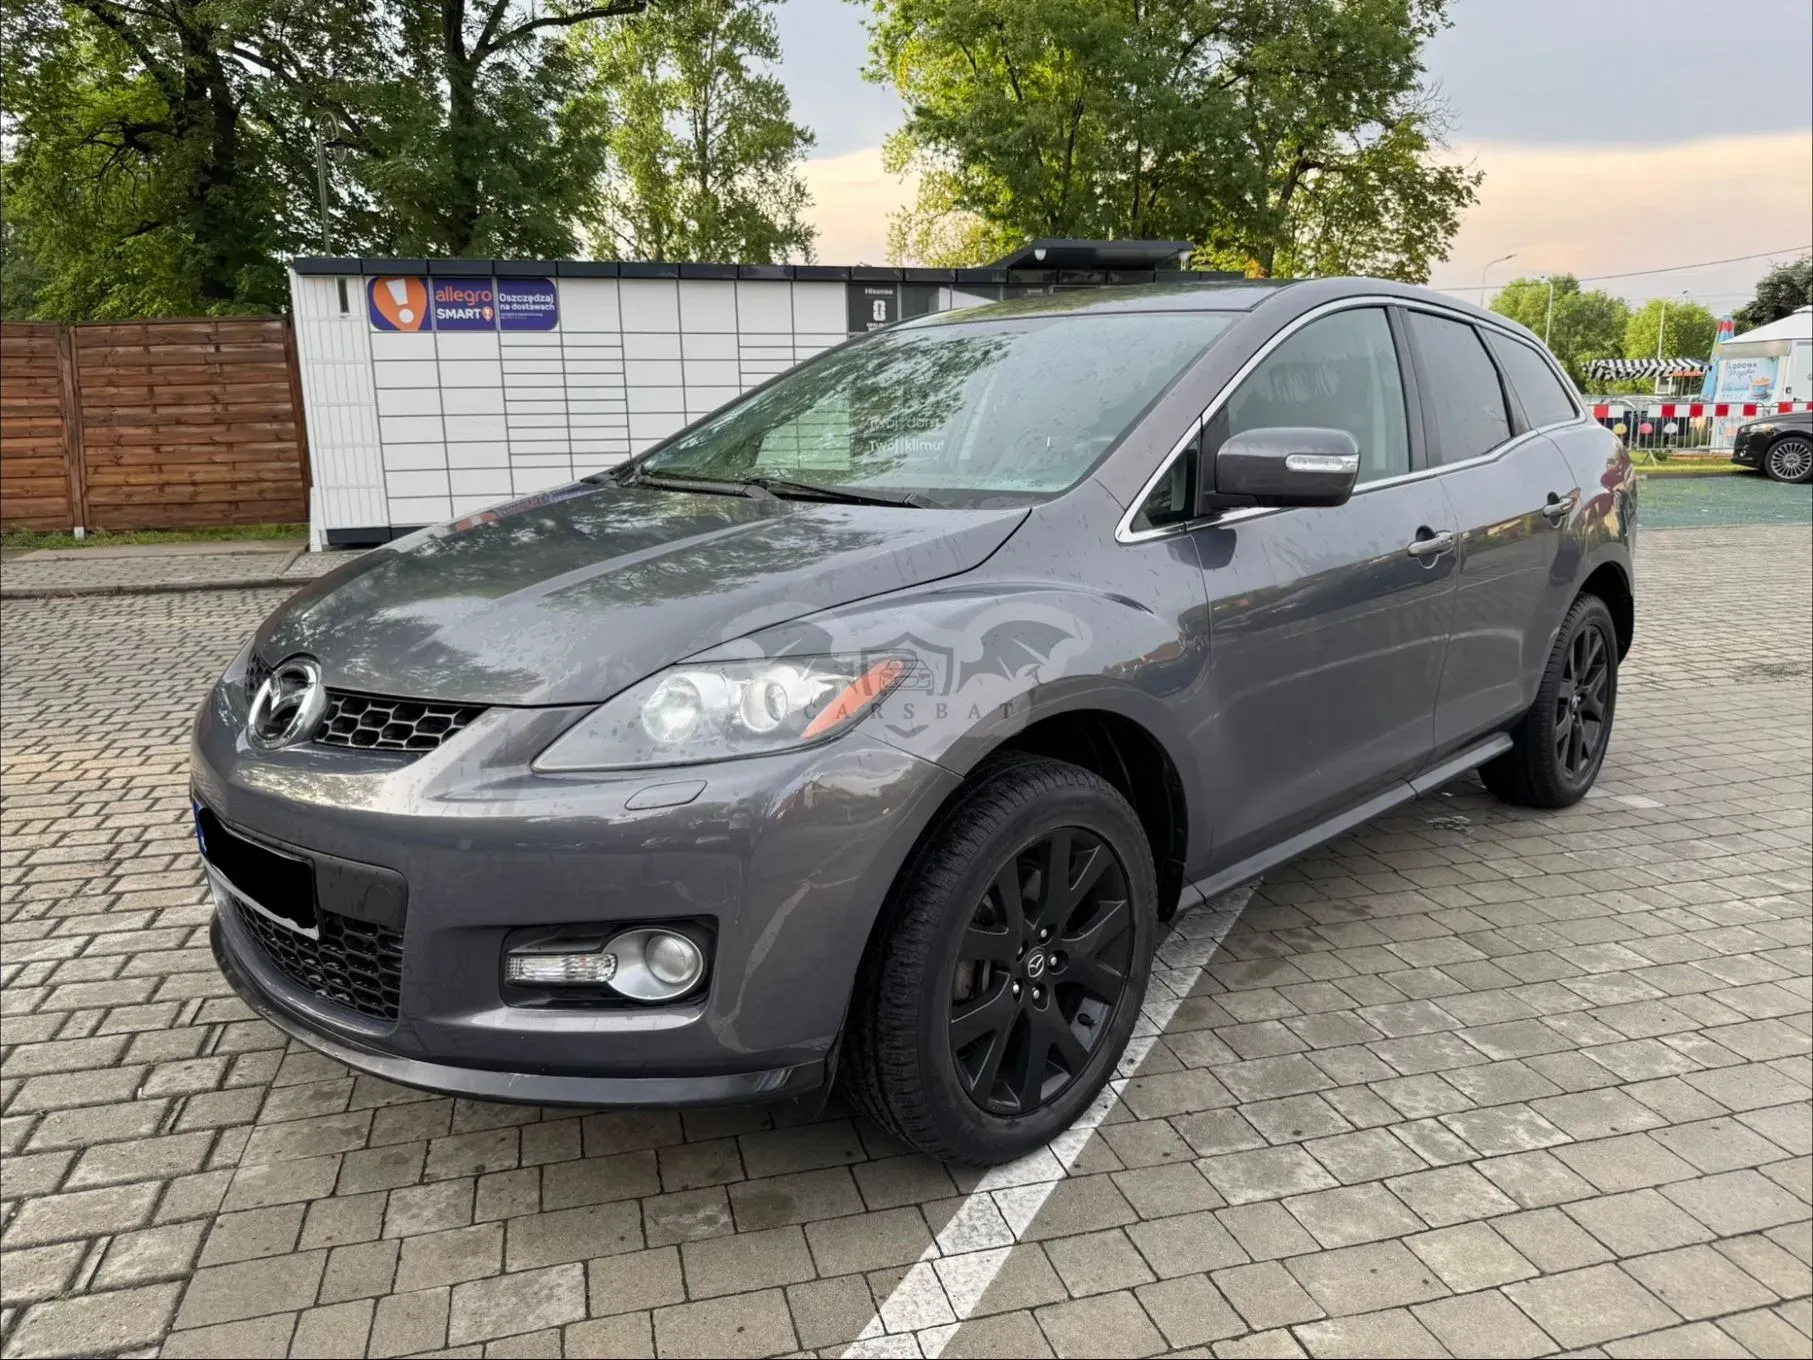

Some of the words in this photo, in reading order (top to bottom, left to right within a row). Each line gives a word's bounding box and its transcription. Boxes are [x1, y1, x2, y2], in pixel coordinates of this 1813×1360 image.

[436, 286, 492, 306] allegro
[500, 293, 554, 304] Oszczędzaj
[511, 303, 555, 311] dostawach
[437, 308, 481, 319] SMART
